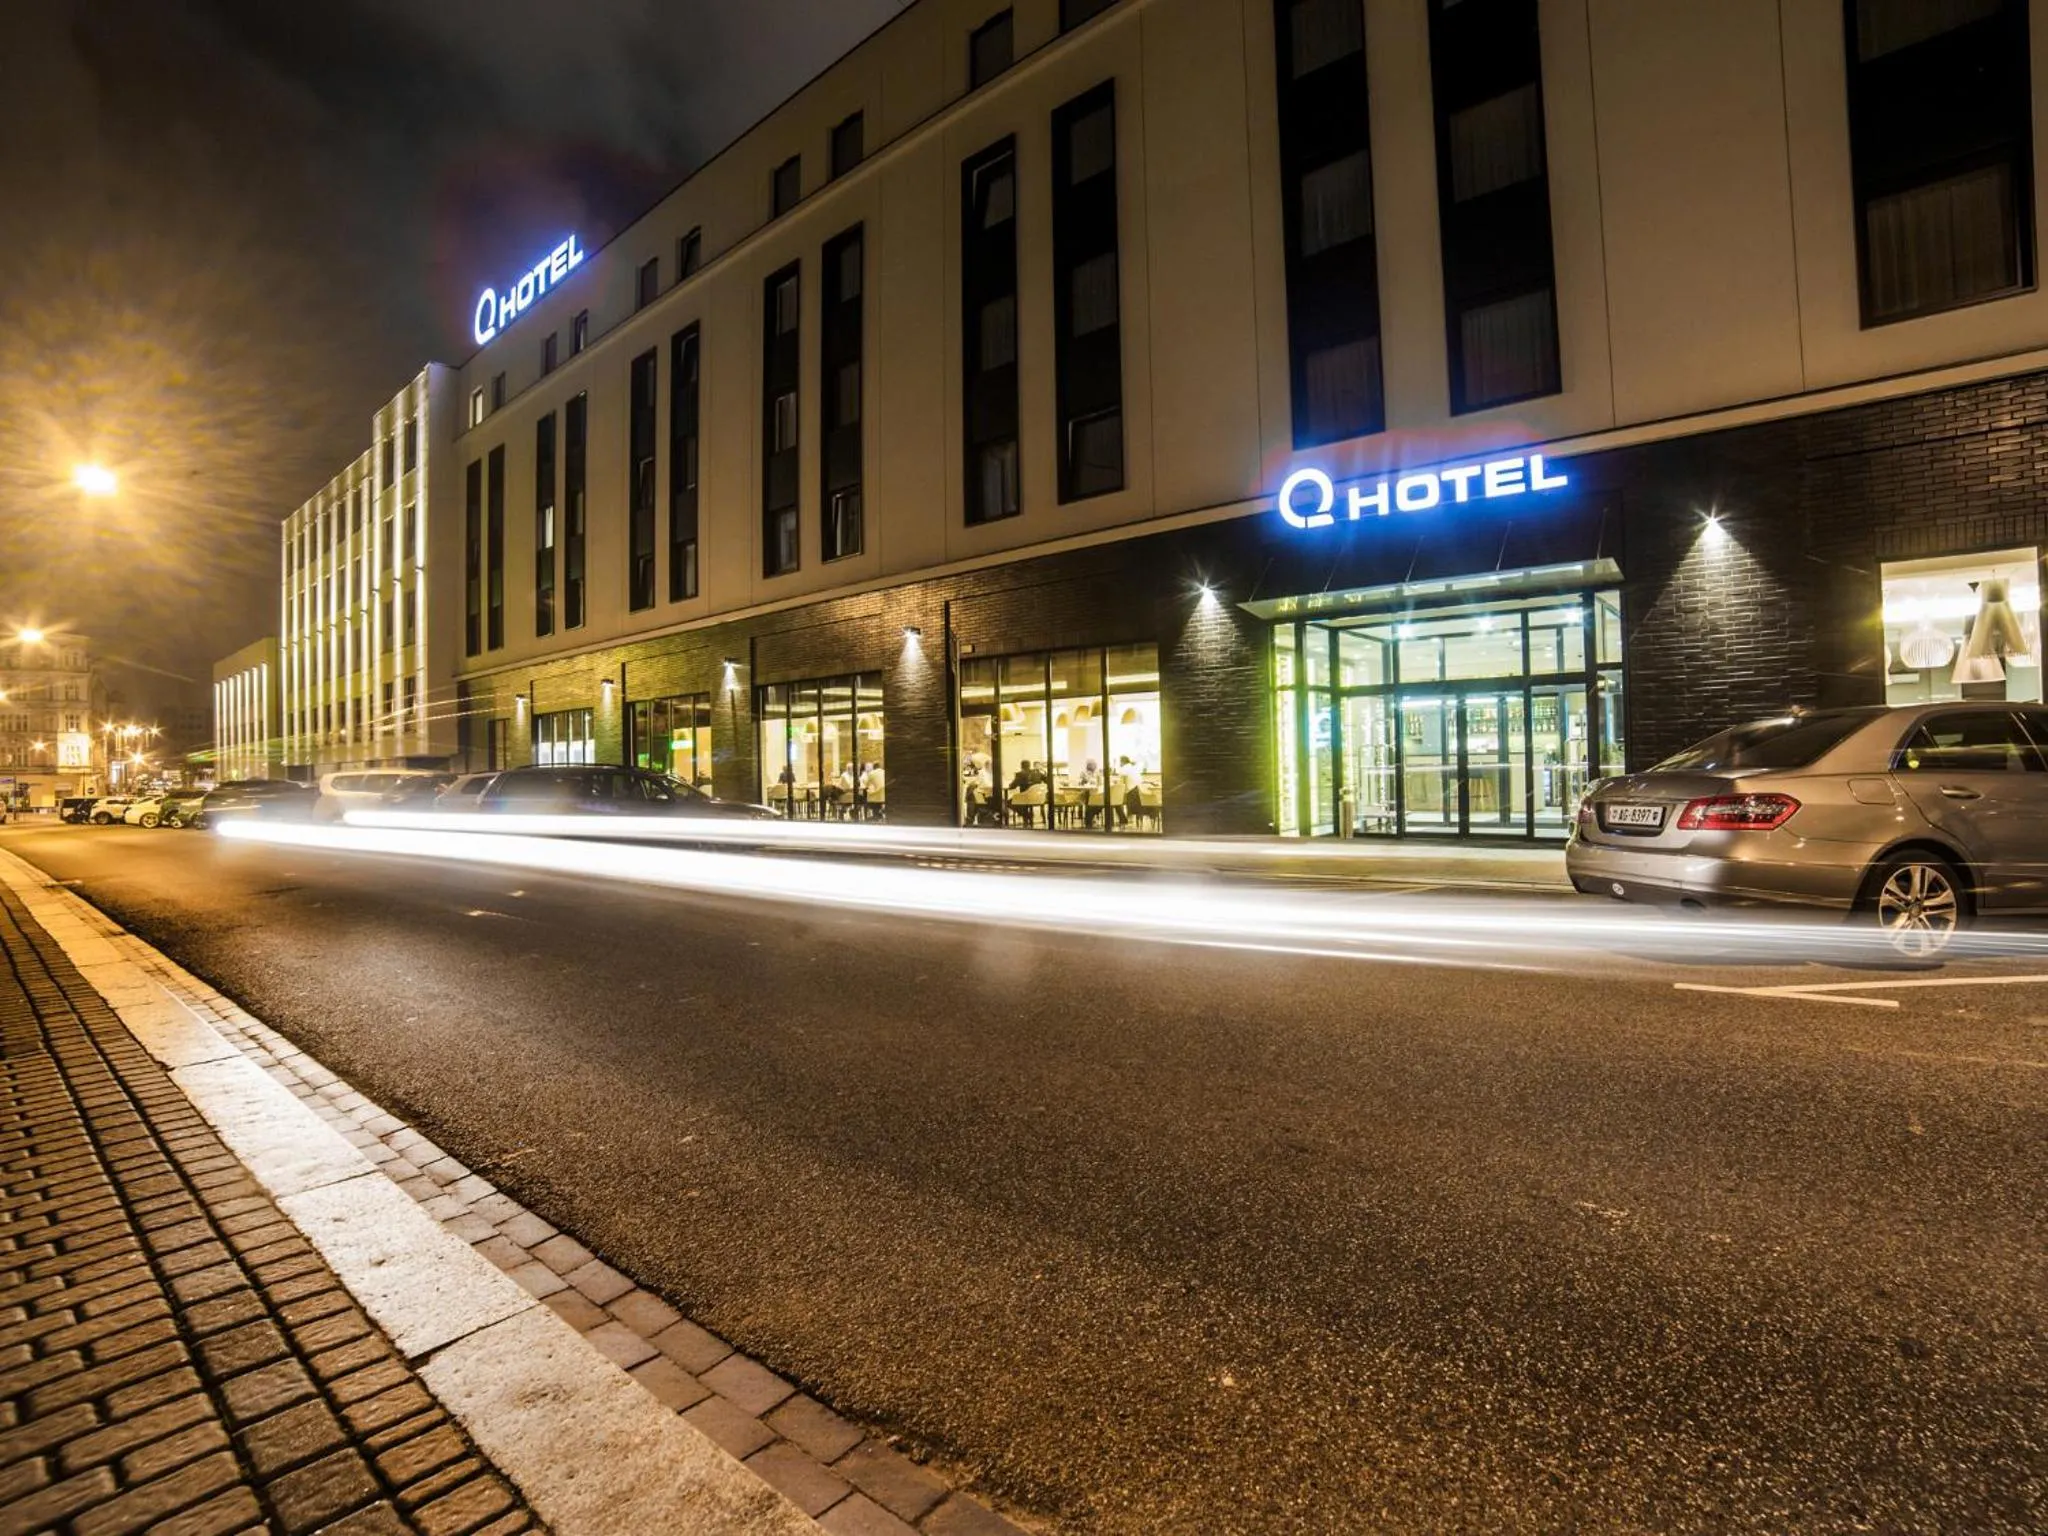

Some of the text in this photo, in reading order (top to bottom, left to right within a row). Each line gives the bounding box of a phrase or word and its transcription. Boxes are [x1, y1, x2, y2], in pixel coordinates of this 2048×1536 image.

[475, 234, 584, 345] Q HOTEL
[1278, 454, 1568, 529] Q HOTEL
